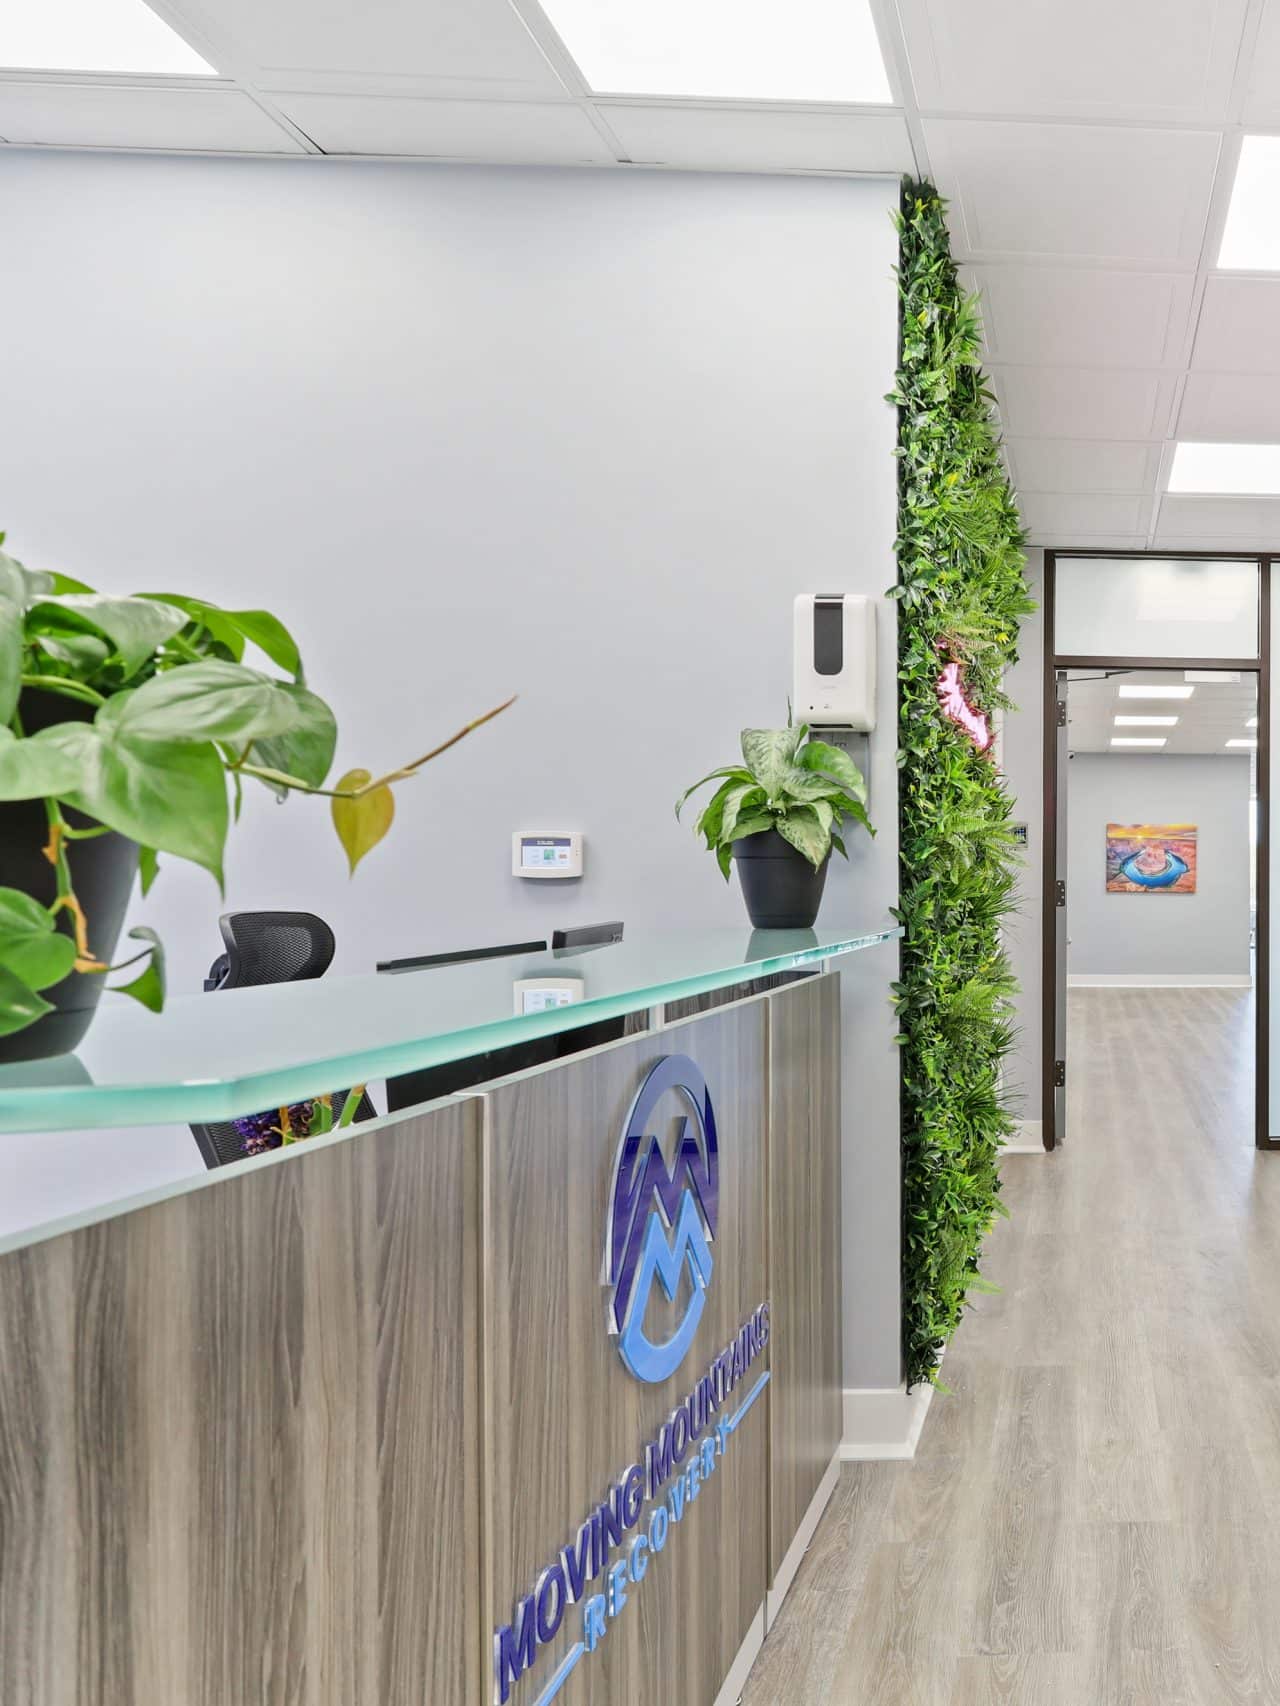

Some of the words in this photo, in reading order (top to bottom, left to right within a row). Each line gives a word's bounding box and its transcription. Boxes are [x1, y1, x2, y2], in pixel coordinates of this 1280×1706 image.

[494, 1463, 643, 1706] MOVING
[646, 1303, 769, 1500] MOUNTAINS
[584, 1413, 731, 1652] RECOVERY
